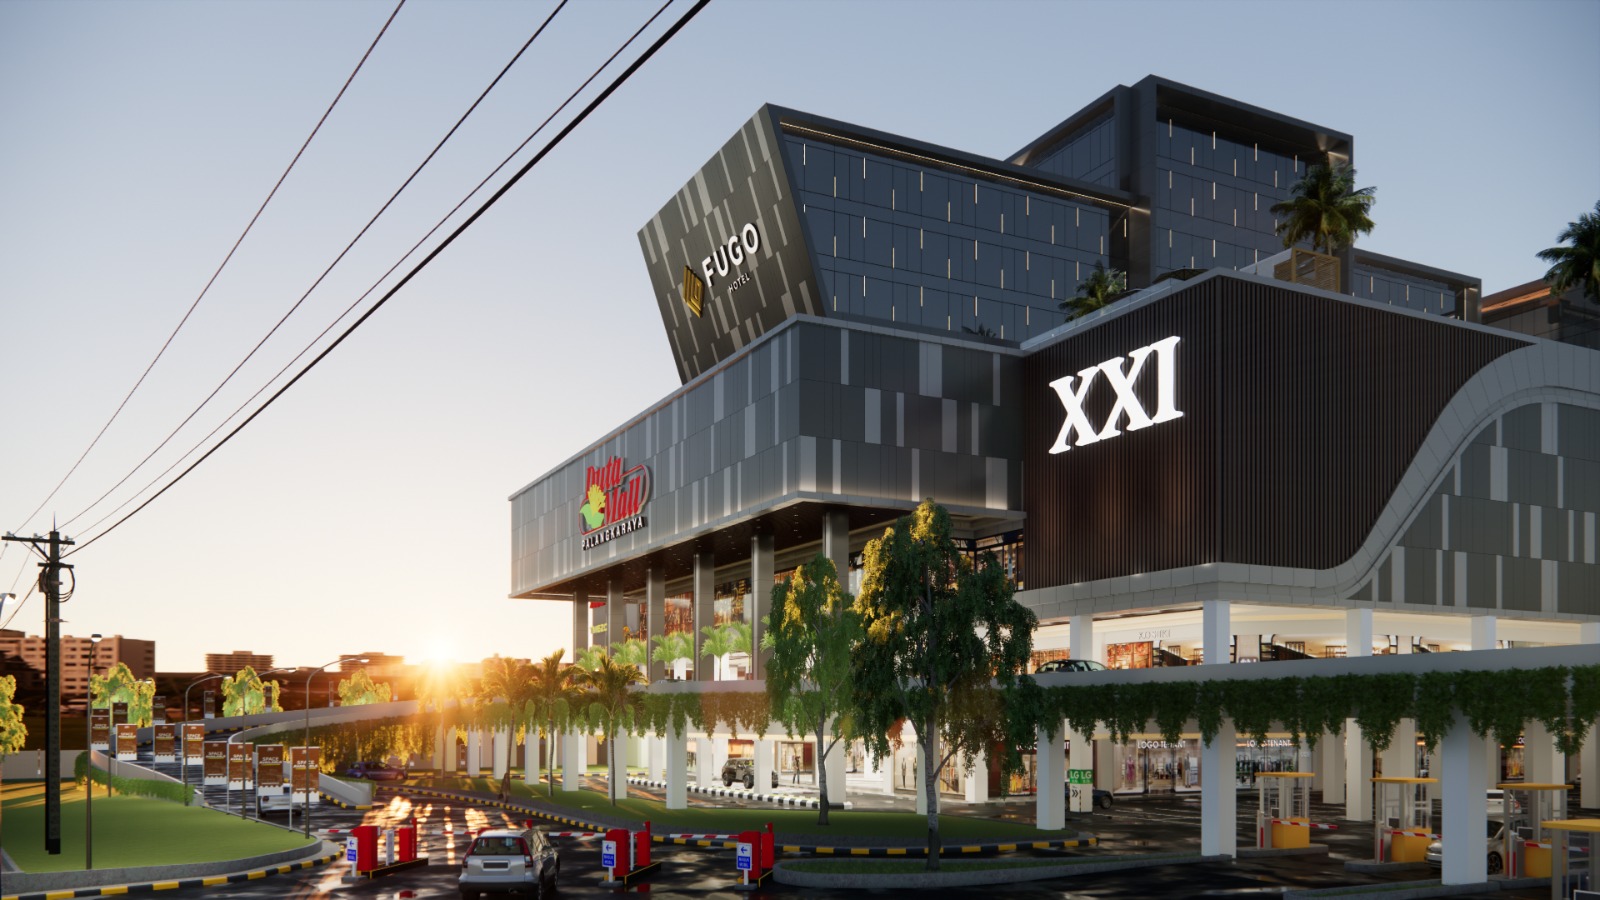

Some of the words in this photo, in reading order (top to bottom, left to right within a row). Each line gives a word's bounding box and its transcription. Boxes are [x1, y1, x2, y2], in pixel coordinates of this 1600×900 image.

[702, 223, 759, 287] FUGO
[728, 273, 751, 293] HOTEL
[1048, 335, 1184, 455] XXI
[586, 456, 622, 498] Duta
[604, 475, 641, 525] Mall
[581, 515, 644, 551] PALANGKARAYA
[1137, 741, 1159, 749] LOGO
[1267, 739, 1291, 748] TENANT
[1070, 770, 1080, 779] LG
[1081, 770, 1092, 779] LG
